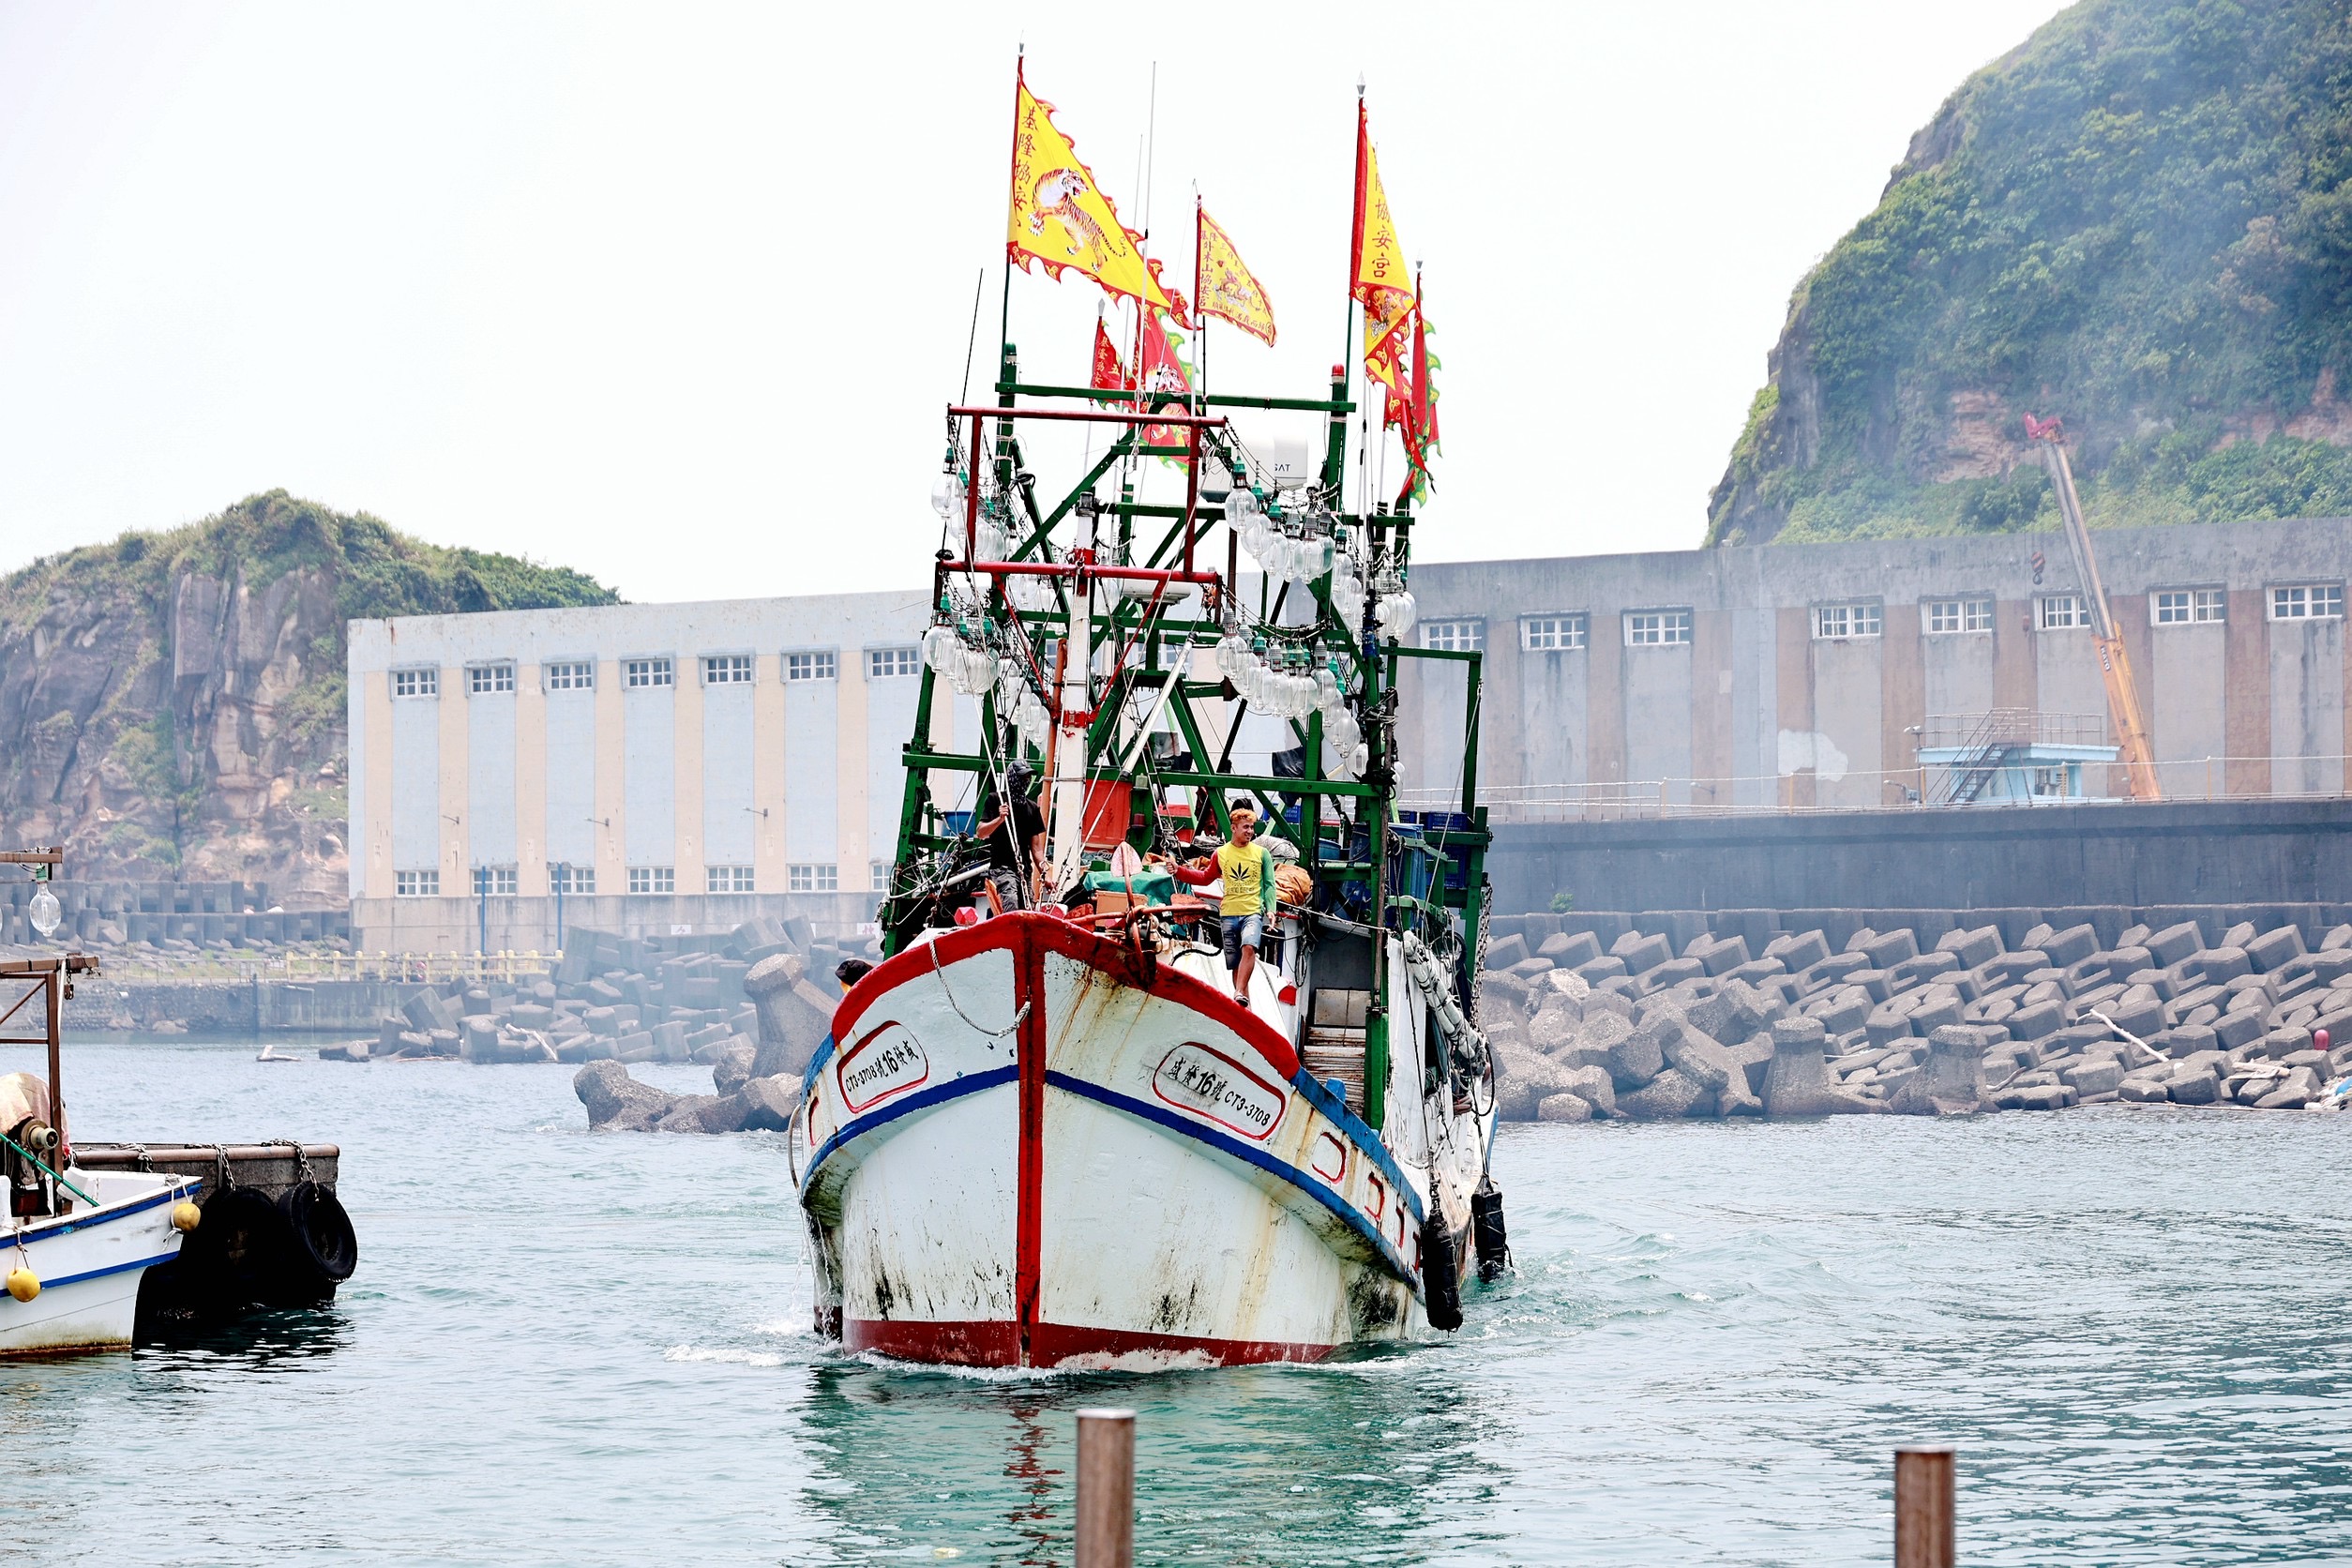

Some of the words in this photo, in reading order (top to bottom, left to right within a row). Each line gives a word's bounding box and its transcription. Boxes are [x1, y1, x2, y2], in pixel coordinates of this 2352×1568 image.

[1016, 105, 1039, 227] 基隆協安
[2101, 645, 2111, 671] KATO
[1224, 1091, 1271, 1126] CT3-3708
